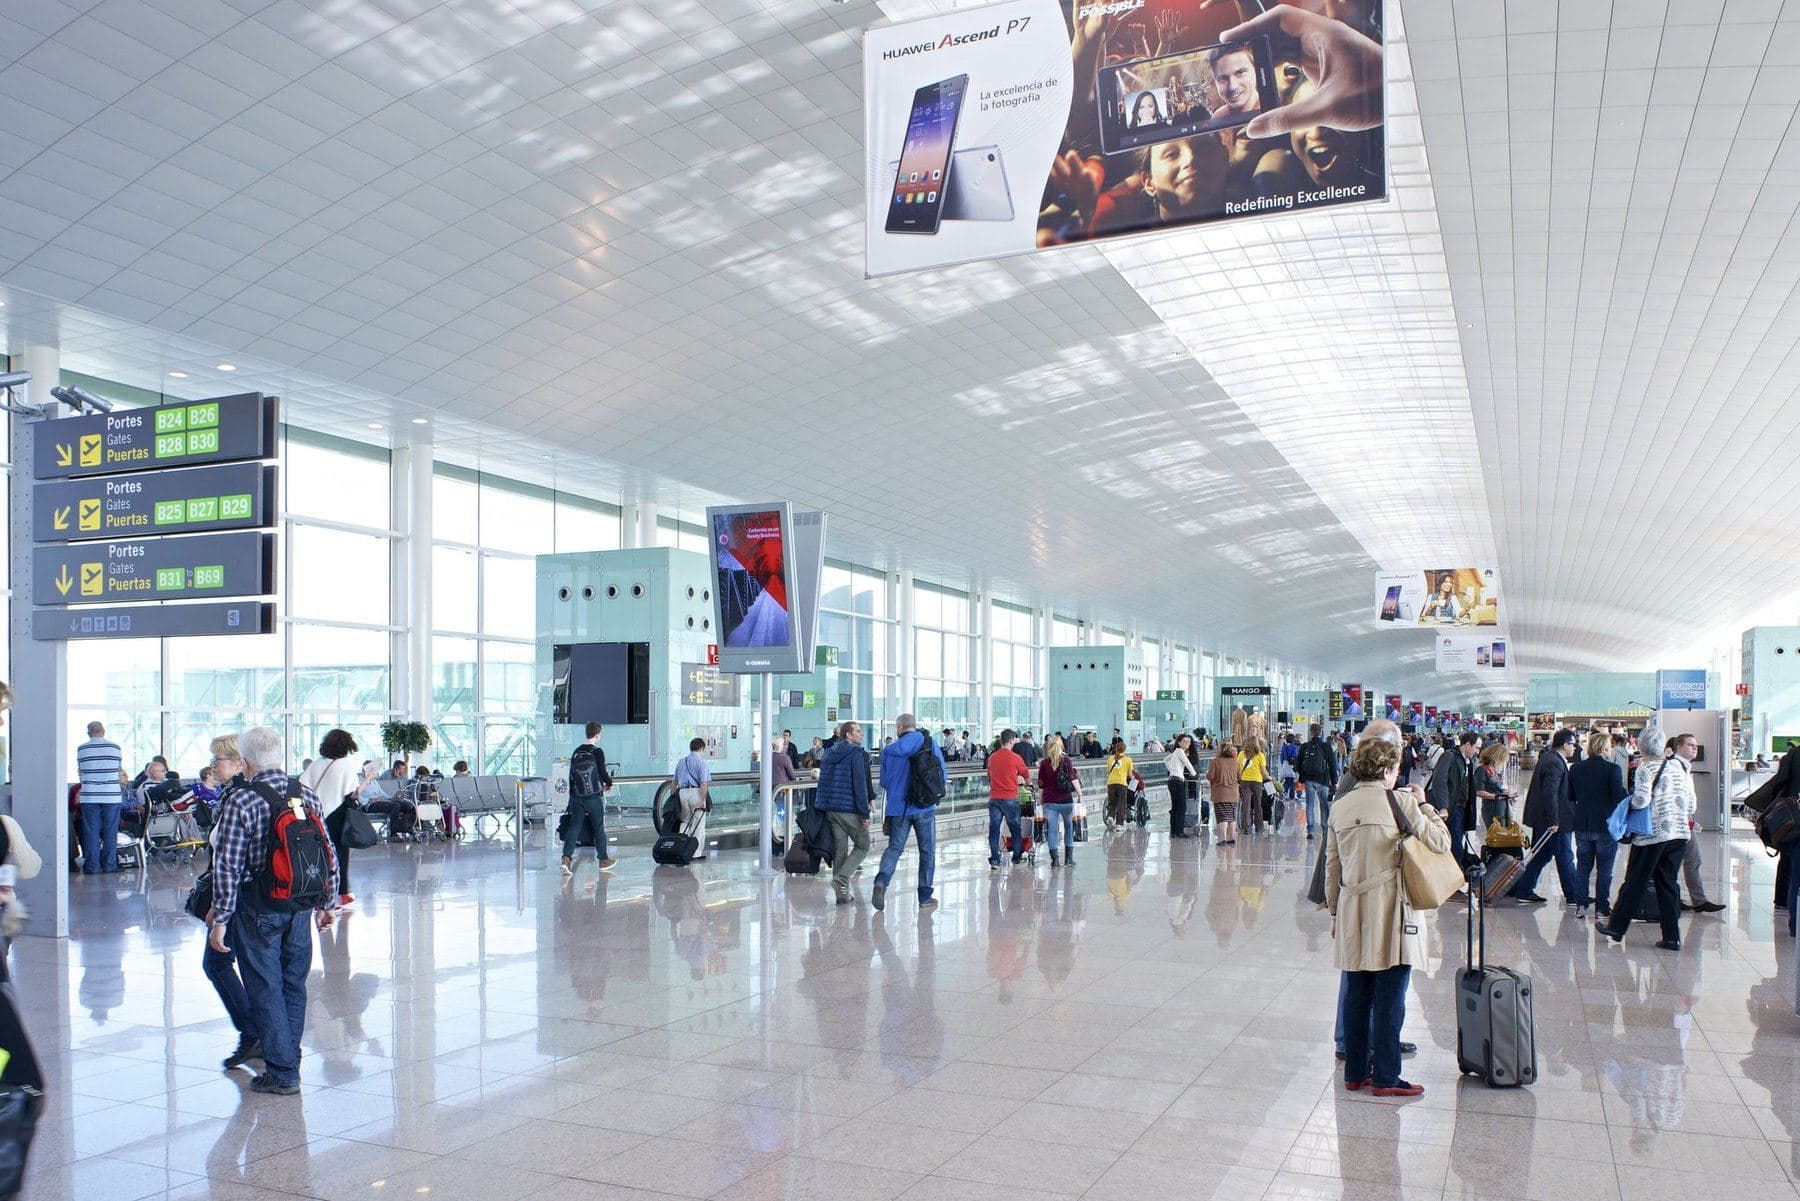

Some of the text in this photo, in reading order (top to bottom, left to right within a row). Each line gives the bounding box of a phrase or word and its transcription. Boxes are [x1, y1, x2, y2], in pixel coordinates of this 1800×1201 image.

[882, 16, 1031, 60] HUAWEI Ascend P7
[980, 77, 1058, 100] La excelencia de
[980, 102, 989, 112] la
[1225, 184, 1366, 214] Redefining Excellence
[107, 415, 142, 430] Portes
[159, 407, 215, 429] B24 B26
[107, 433, 131, 446] Gates
[159, 432, 215, 454] B28 B30
[107, 448, 149, 463] Puertas
[106, 481, 142, 495] Portes
[106, 498, 131, 511] Gates
[158, 498, 248, 520] B25 B27 B29
[106, 513, 148, 528] Puertas
[109, 544, 145, 558] Portes
[109, 562, 134, 575] Gates
[186, 569, 193, 577] to
[109, 577, 151, 591] Puertas
[160, 569, 220, 586] B31 B69
[187, 579, 193, 587] a
[1663, 682, 1705, 691] AMERICAN
